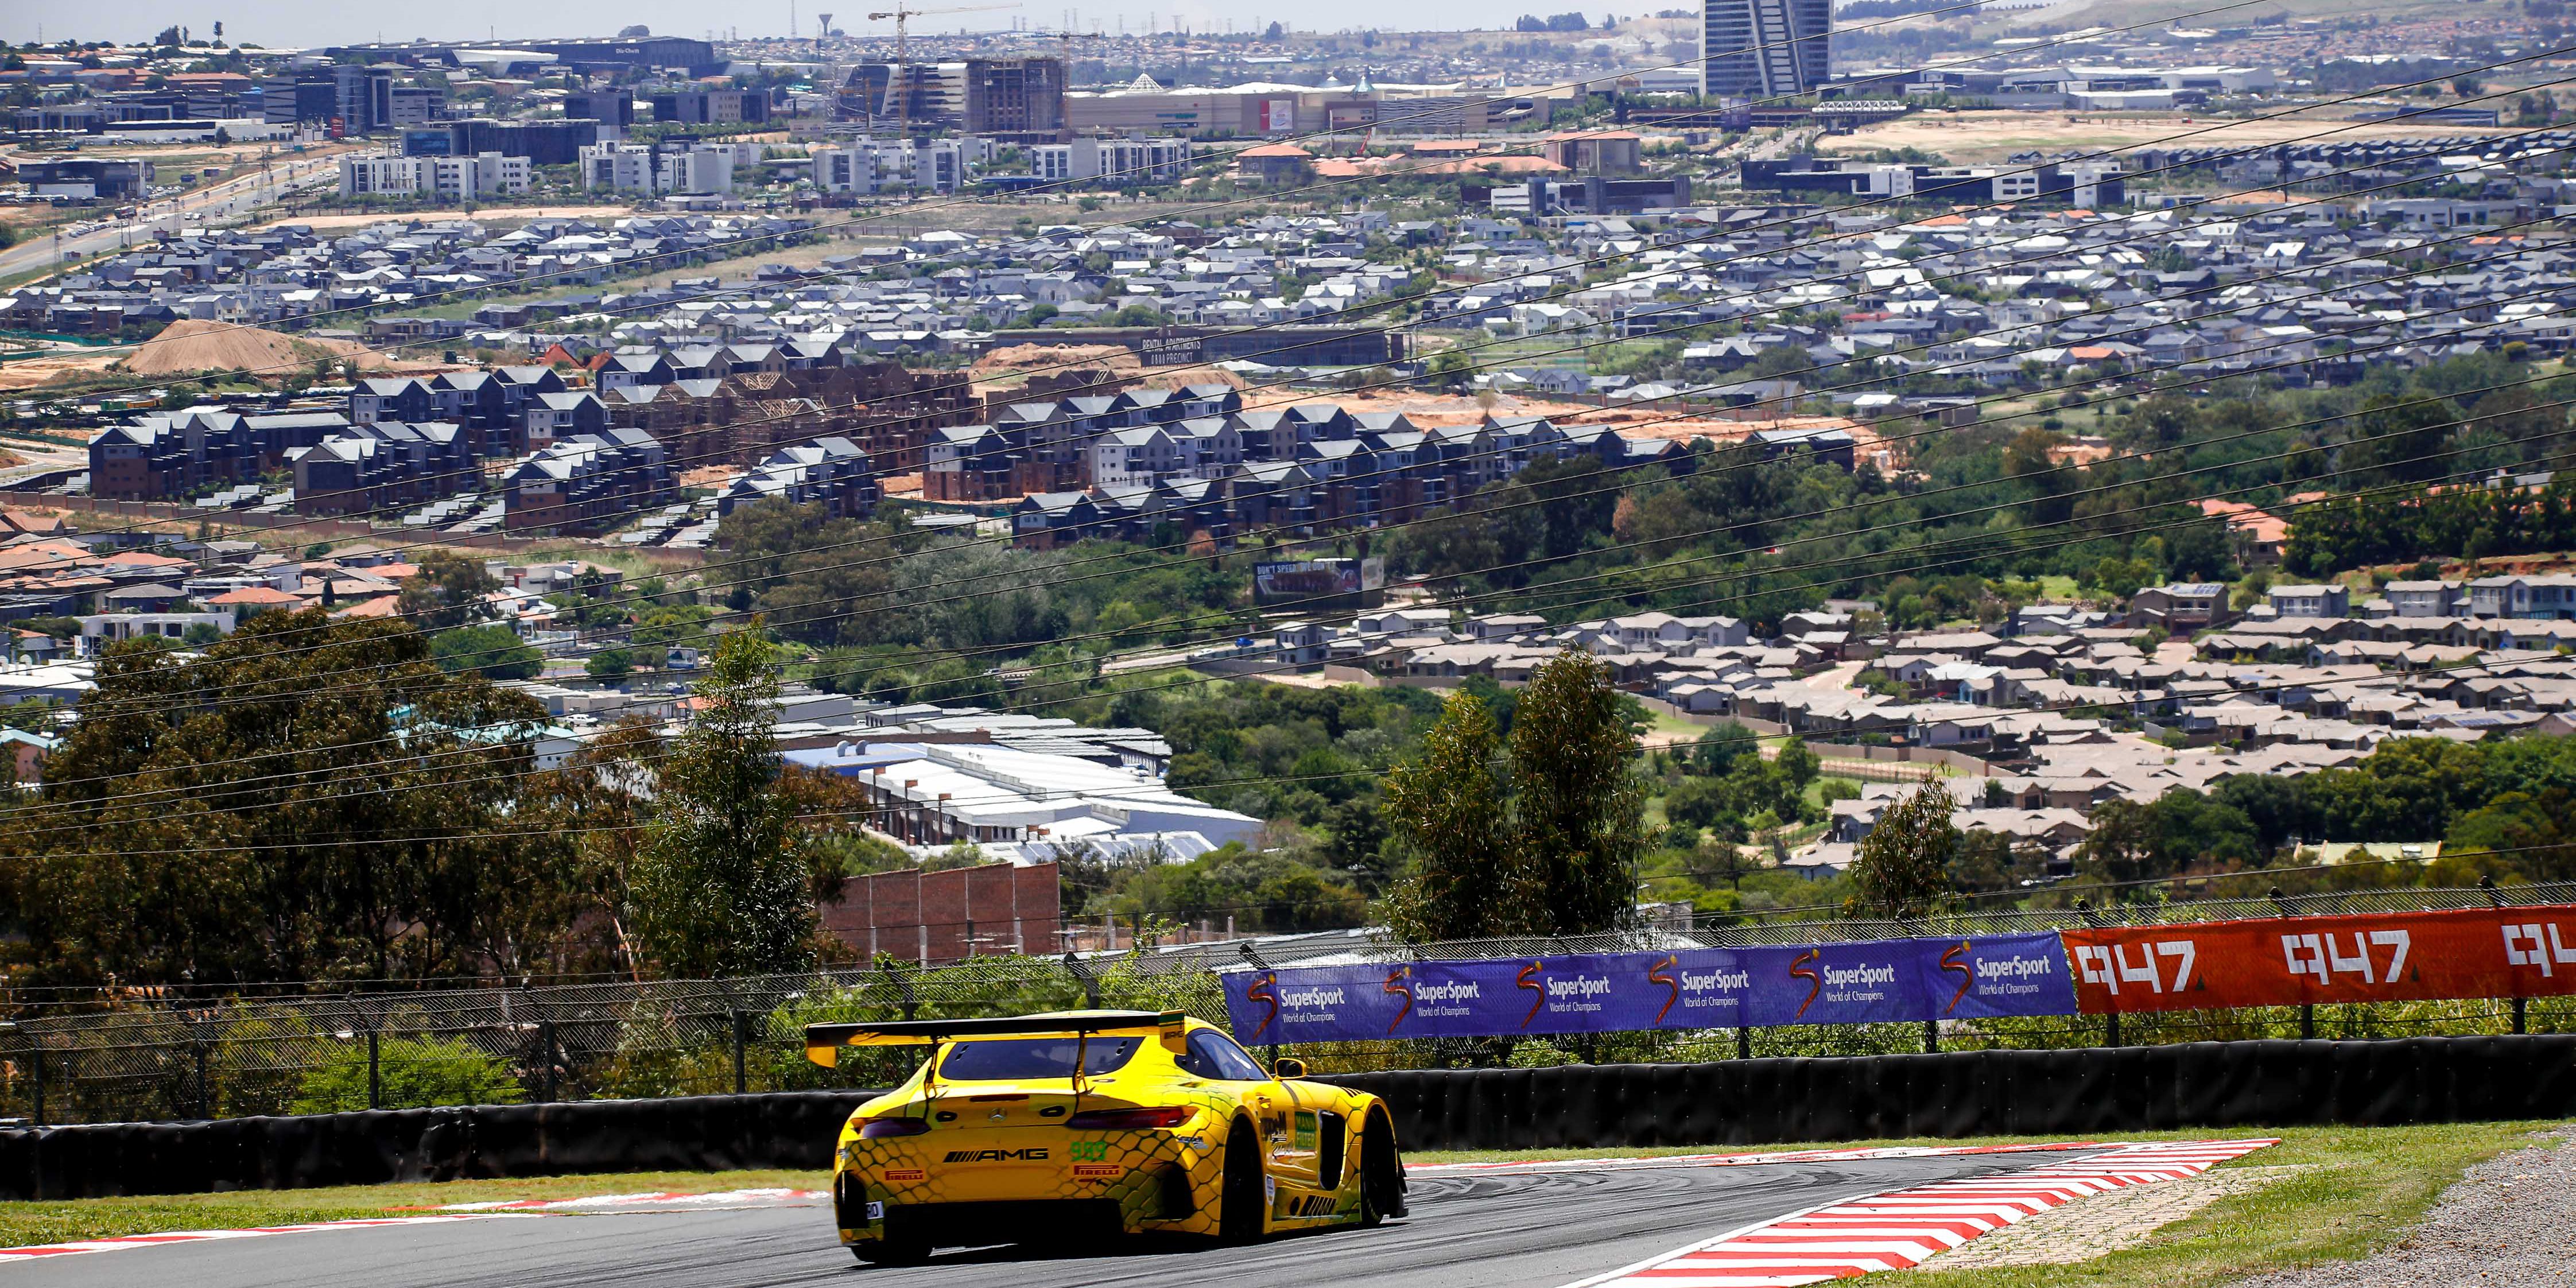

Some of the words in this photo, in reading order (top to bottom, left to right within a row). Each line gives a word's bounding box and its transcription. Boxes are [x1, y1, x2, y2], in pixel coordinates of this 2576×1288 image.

[1143, 339, 1163, 352] RENTAL
[1166, 337, 1201, 351] APARTMENTS
[1166, 352, 1193, 363] PRECINCT
[2281, 929, 2411, 985] 947
[1976, 955, 2051, 981] SuperSport
[2074, 940, 2195, 995] 947
[1681, 969, 1749, 995] SuperSport
[1824, 963, 1895, 989] SuperSport
[1415, 980, 1480, 1004] SuperSport
[1547, 975, 1611, 1000] SuperSport
[1979, 984, 1997, 995] World
[1998, 984, 2004, 994] of
[2006, 983, 2039, 996] Champions
[1281, 987, 1345, 1010] SuperSport
[1684, 997, 1700, 1007] World
[1701, 996, 1707, 1006] of
[1708, 996, 1739, 1008] Champions
[1826, 991, 1843, 1002] World
[1844, 991, 1850, 1001] of
[1852, 991, 1884, 1003] Champions
[1417, 1007, 1433, 1017] World
[1434, 1006, 1440, 1016] of
[1441, 1006, 1470, 1018] Champions
[1550, 1002, 1565, 1011] World
[1566, 1002, 1572, 1011] of
[1573, 1001, 1601, 1013] Champions
[1282, 1012, 1299, 1023] World
[1299, 1012, 1306, 1022] of
[1306, 1012, 1336, 1025] Champions
[976, 1147, 1048, 1162] AMG
[1070, 1141, 1107, 1161] 999
[885, 1170, 924, 1181] PIRELLI
[1074, 1165, 1119, 1176] PIRELLI
